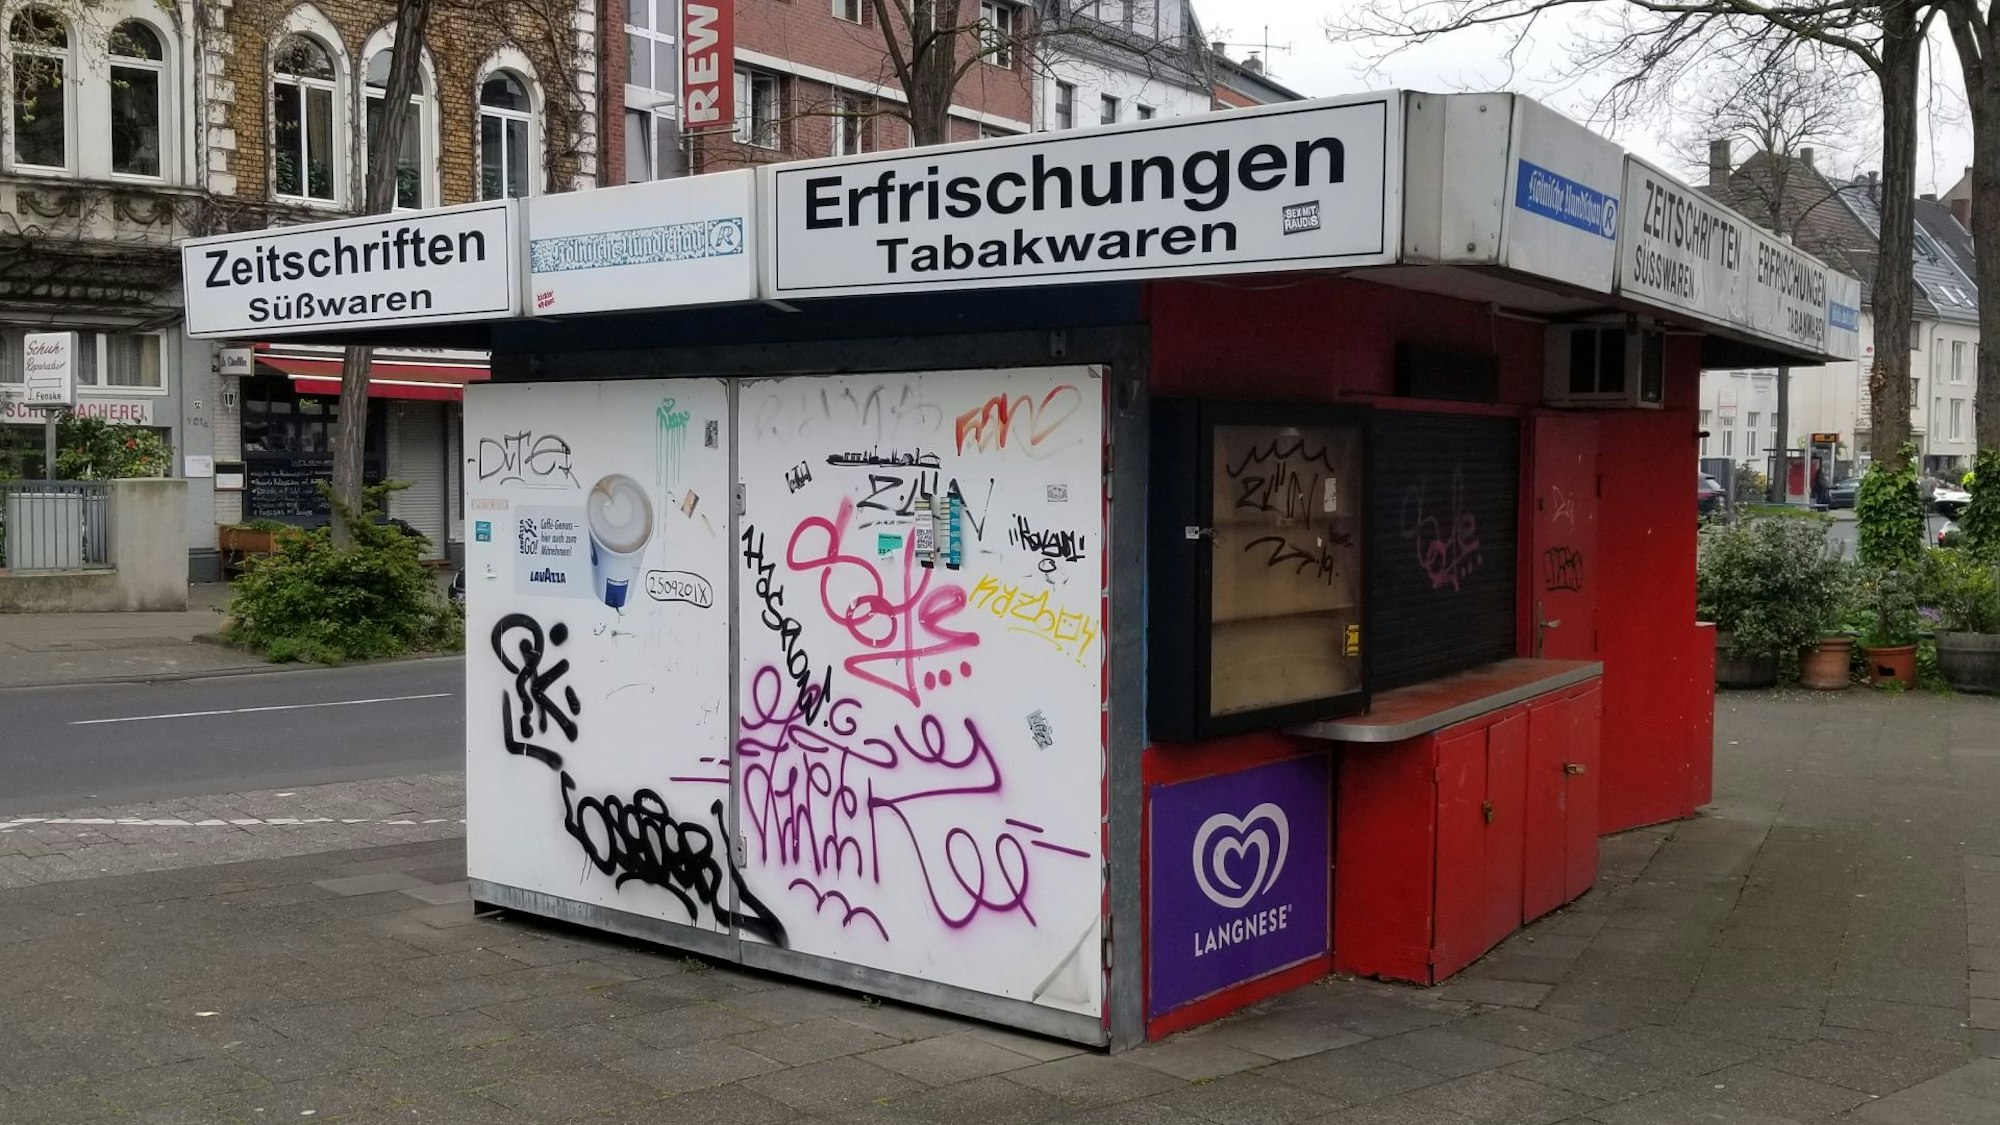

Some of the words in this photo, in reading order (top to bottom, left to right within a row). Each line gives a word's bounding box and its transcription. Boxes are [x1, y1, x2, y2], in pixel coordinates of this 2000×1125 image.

[805, 136, 1346, 231] Erfrischungen
[205, 227, 486, 288] Zeitschriften
[876, 221, 1238, 274] Tabakwaren
[1634, 238, 1694, 300] SÜSSWAREN
[248, 288, 433, 323] Süßwaren
[26, 339, 64, 356] Schuh-
[36, 391, 62, 400] Fenske
[530, 568, 566, 583] LAVAZZA
[1194, 904, 1288, 957] LANGNESE
